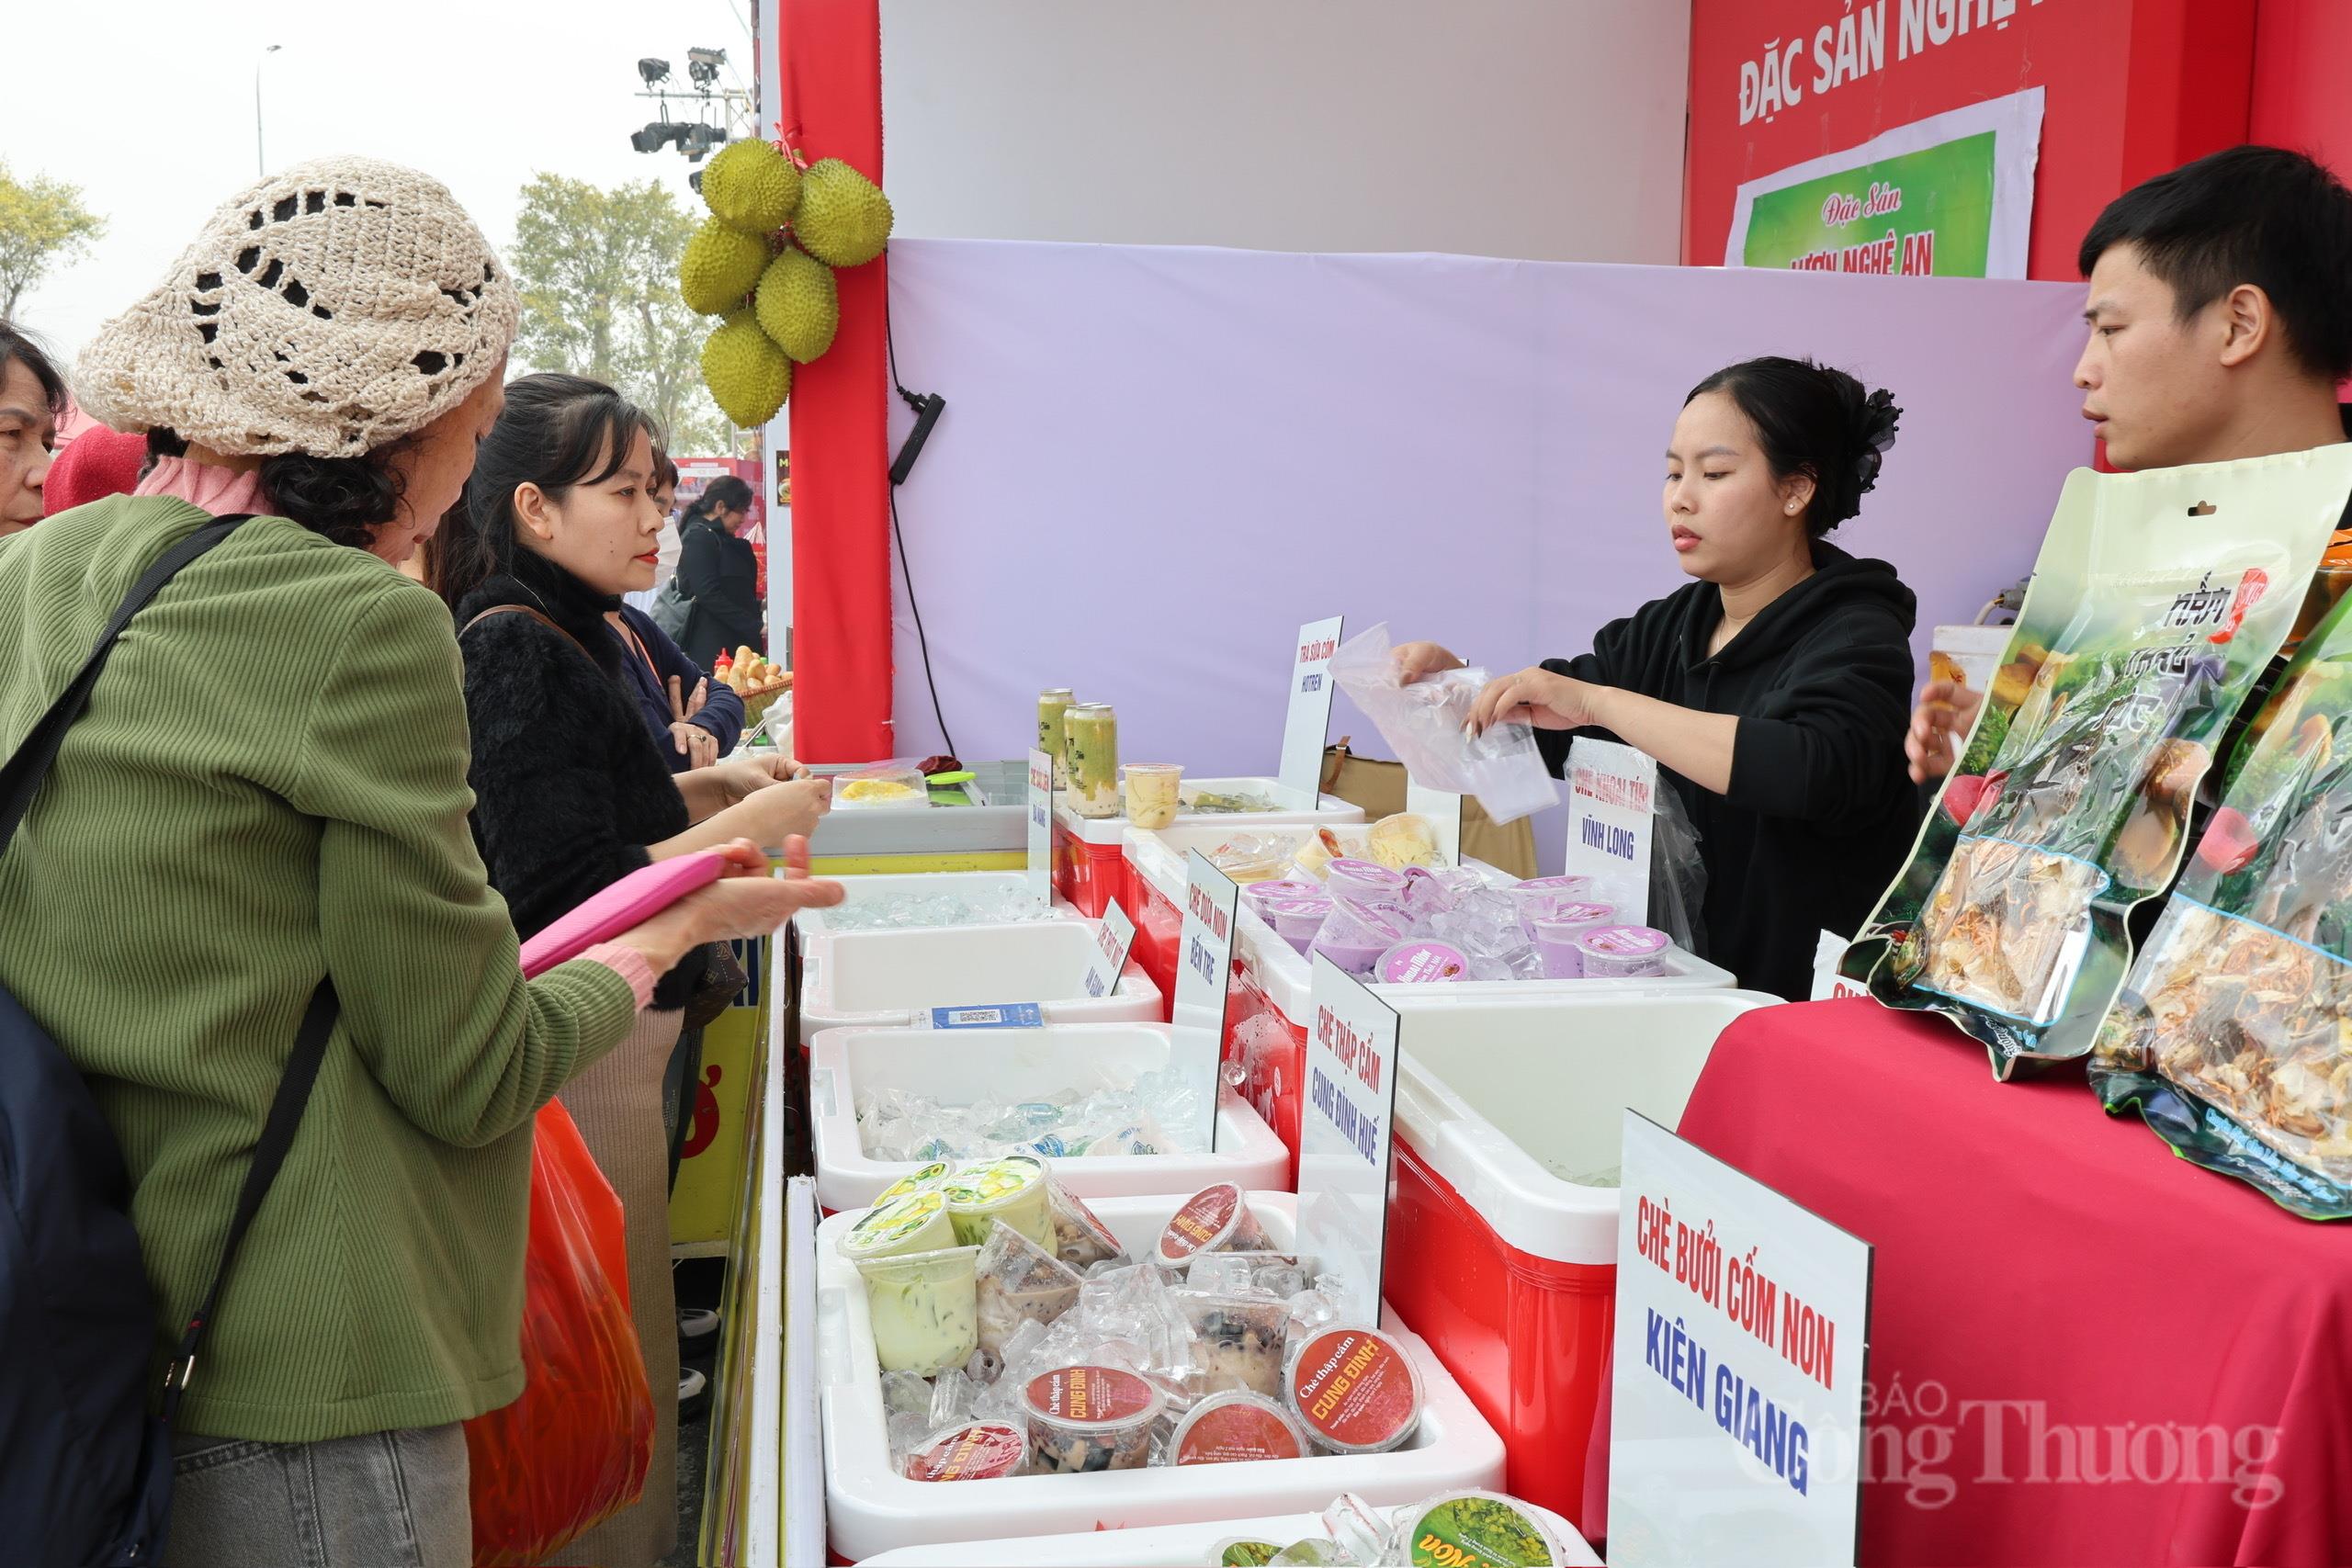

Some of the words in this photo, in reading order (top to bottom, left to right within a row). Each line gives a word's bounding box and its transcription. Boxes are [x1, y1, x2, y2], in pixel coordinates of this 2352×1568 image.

[1739, 37, 1803, 126] ĐẶC
[1813, 0, 1884, 95] SẢN
[1822, 193, 1860, 228] Đặc
[1862, 183, 1902, 218] Sản
[1902, 231, 1934, 276] AN
[1582, 814, 1606, 851] VĨNH
[1606, 825, 1634, 861] LONG
[1189, 882, 1202, 918] CHÈ
[1213, 905, 1227, 943] NON
[1190, 933, 1204, 974] BẾN
[1203, 948, 1215, 987] TRE
[1317, 1005, 1335, 1053] CHÈ
[1334, 1021, 1358, 1075] THẬP
[1358, 1032, 1381, 1095] CẨM
[1312, 1066, 1335, 1121] CUNG
[1335, 1087, 1358, 1145] ĐÌNH
[1358, 1113, 1379, 1167] HUẾ
[1637, 1195, 1671, 1273] CHÈ
[1676, 1219, 1722, 1310] BƯỞI
[1726, 1247, 1776, 1349] CỐM
[1781, 1291, 1835, 1391] NON
[1069, 1391, 1086, 1418] CUNG
[1299, 1378, 1319, 1399] Chè
[1316, 1356, 1339, 1382] thập
[1311, 1375, 1351, 1420] CUNG
[1343, 1337, 1380, 1380] ĐÌNH
[1646, 1307, 1706, 1411] KIÊN
[1714, 1363, 1808, 1497] GIANG
